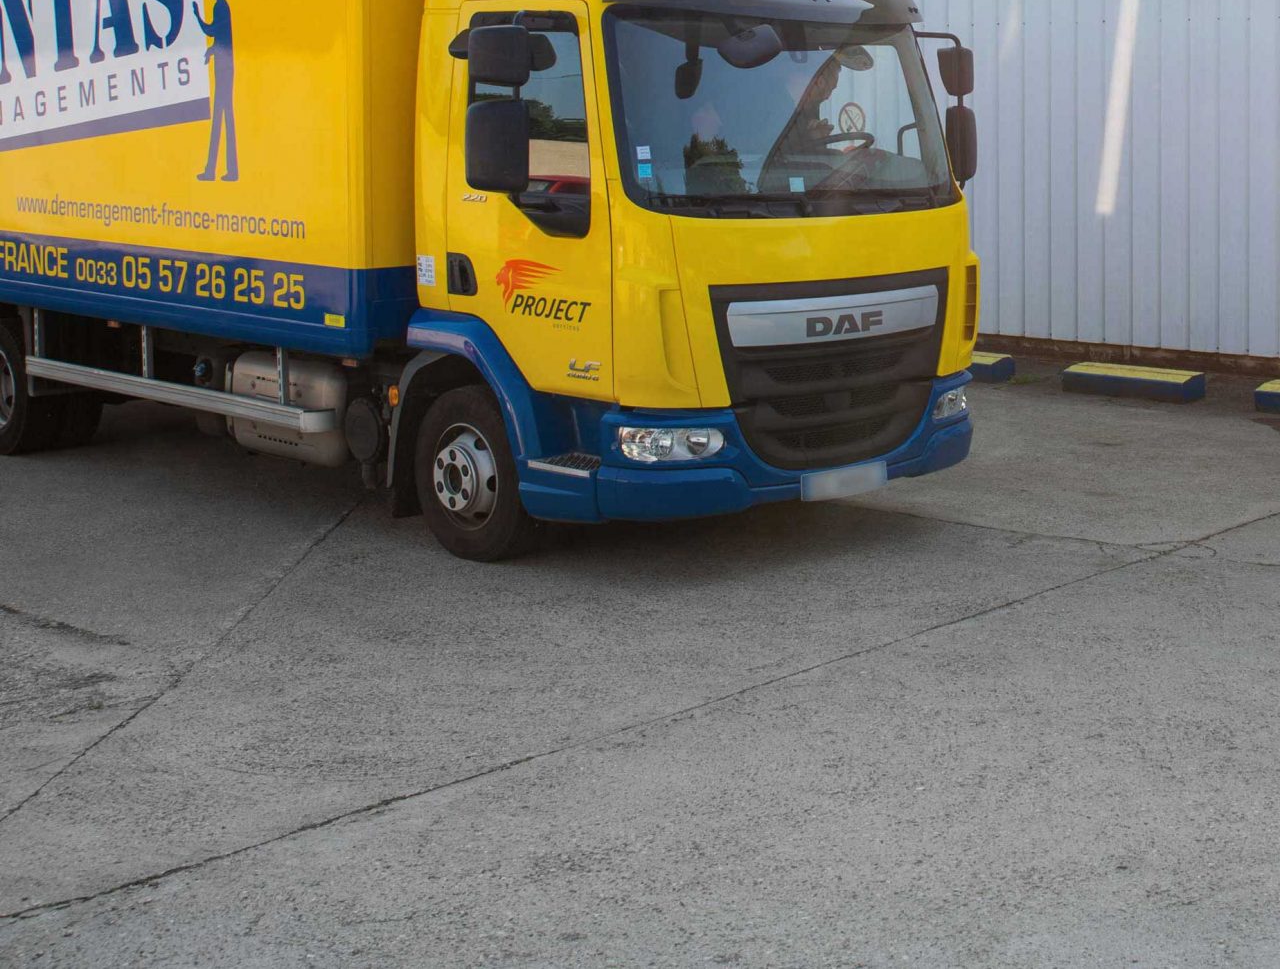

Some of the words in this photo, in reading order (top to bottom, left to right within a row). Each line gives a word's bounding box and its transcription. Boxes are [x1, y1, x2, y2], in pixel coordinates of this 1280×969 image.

[0, 57, 190, 126] AGEMENTS
[16, 194, 305, 239] www.demenagement-france-maroc.com
[76, 258, 117, 285] 0033
[122, 256, 151, 290] 05
[159, 259, 188, 293] 57
[196, 263, 226, 299] 26
[234, 268, 265, 304] 25
[273, 272, 305, 310] 25
[511, 294, 592, 323] PROJECT
[806, 310, 883, 337] DAF
